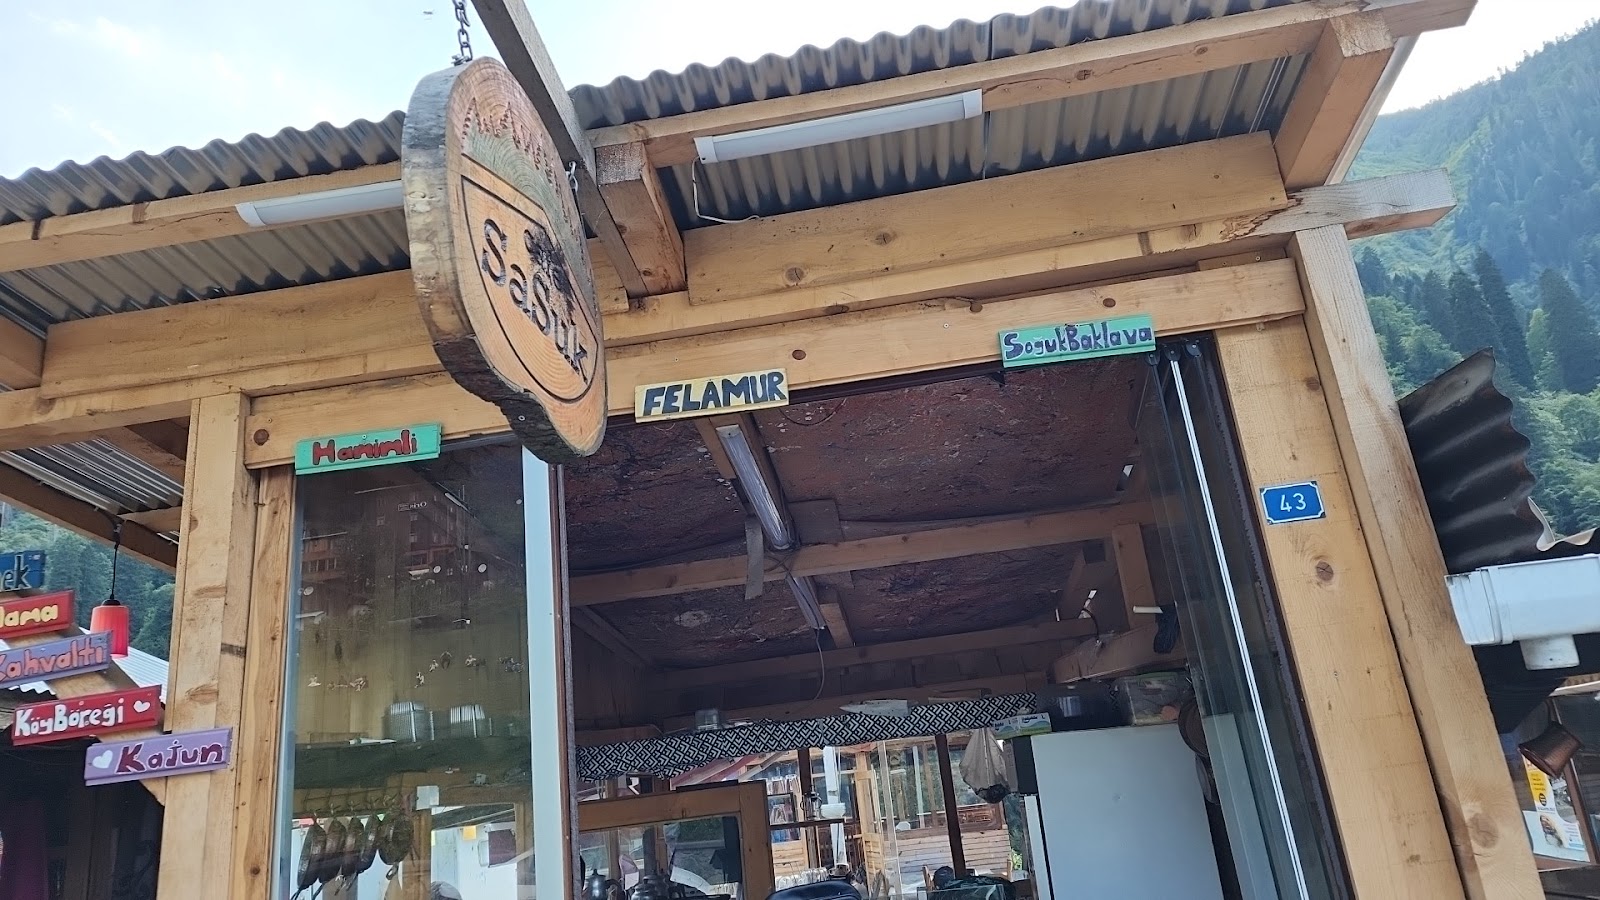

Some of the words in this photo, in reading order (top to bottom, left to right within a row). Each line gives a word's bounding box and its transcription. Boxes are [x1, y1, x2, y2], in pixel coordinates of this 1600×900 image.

[643, 371, 787, 416] FELAMUR
[1280, 493, 1306, 512] 43
[0, 554, 31, 591] ek
